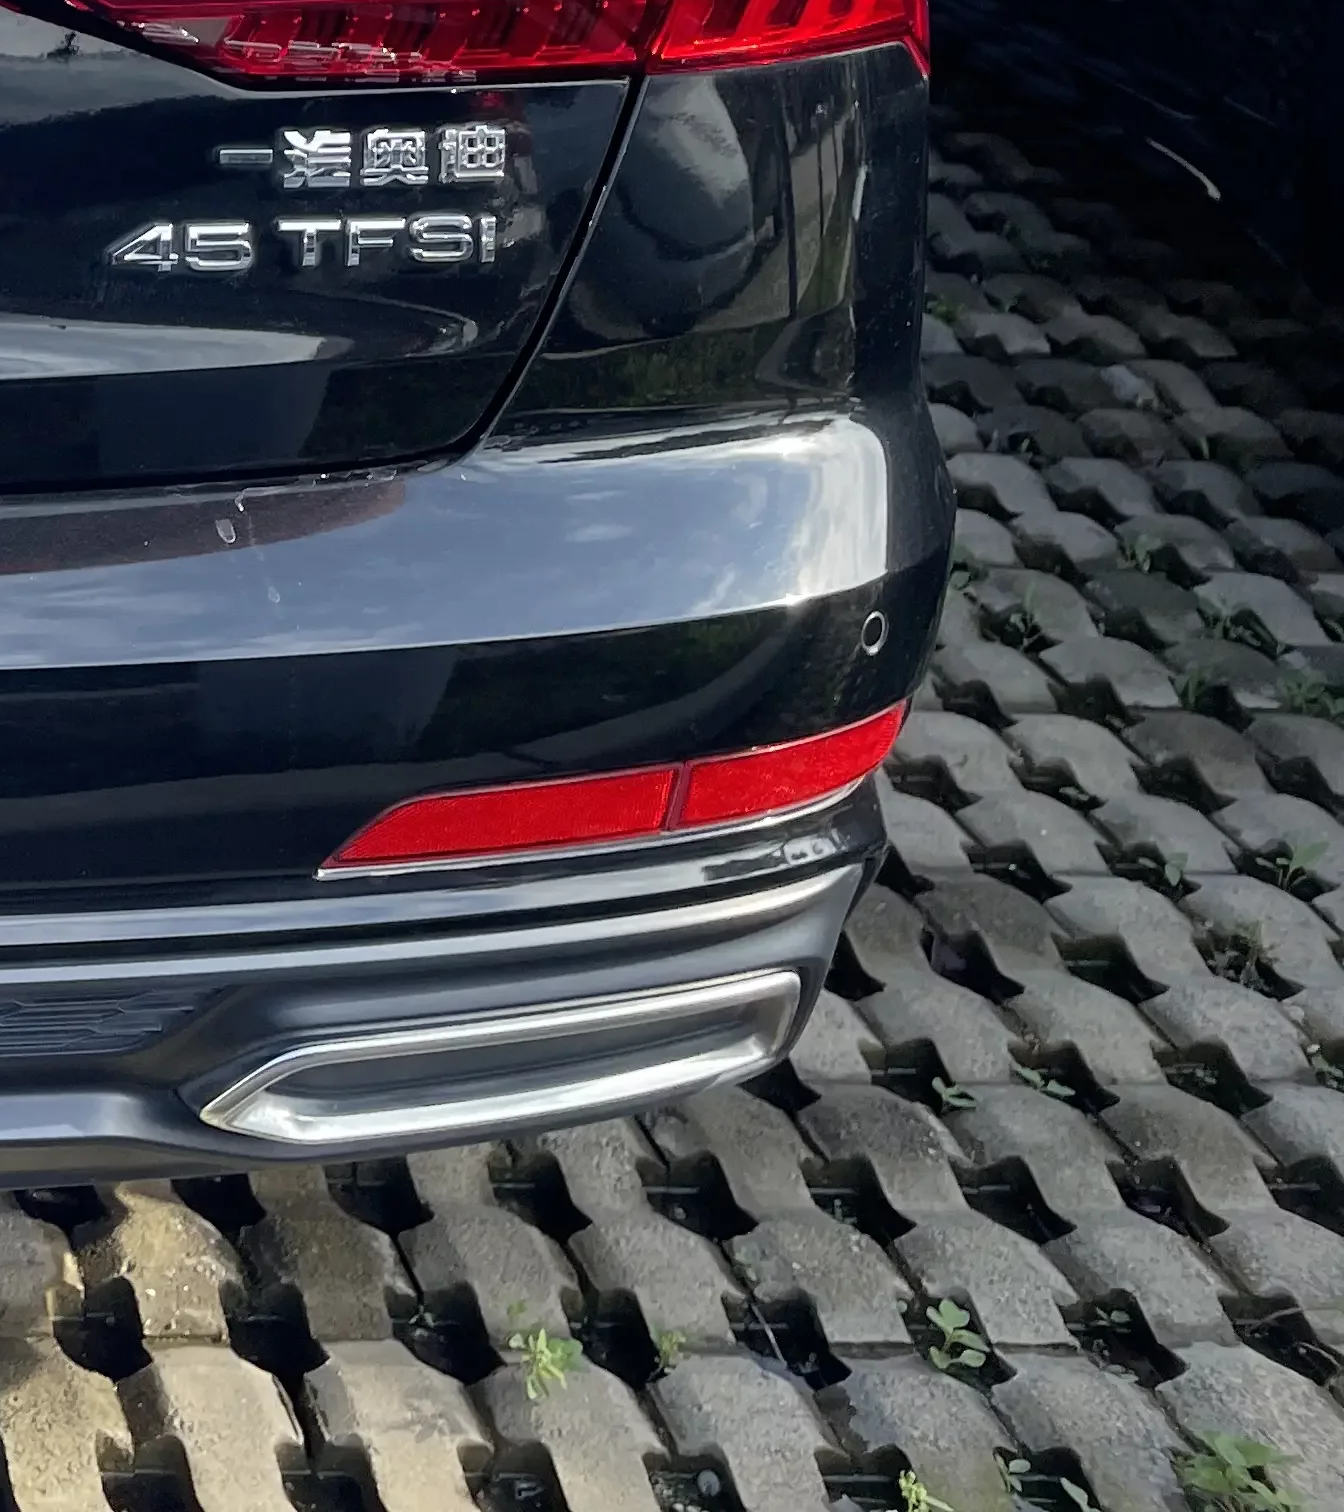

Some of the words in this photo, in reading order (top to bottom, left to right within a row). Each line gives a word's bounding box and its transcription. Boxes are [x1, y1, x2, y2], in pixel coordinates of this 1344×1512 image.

[218, 125, 508, 188] 一汽奥迪
[109, 221, 254, 273] 45
[277, 214, 497, 267] TFSI
